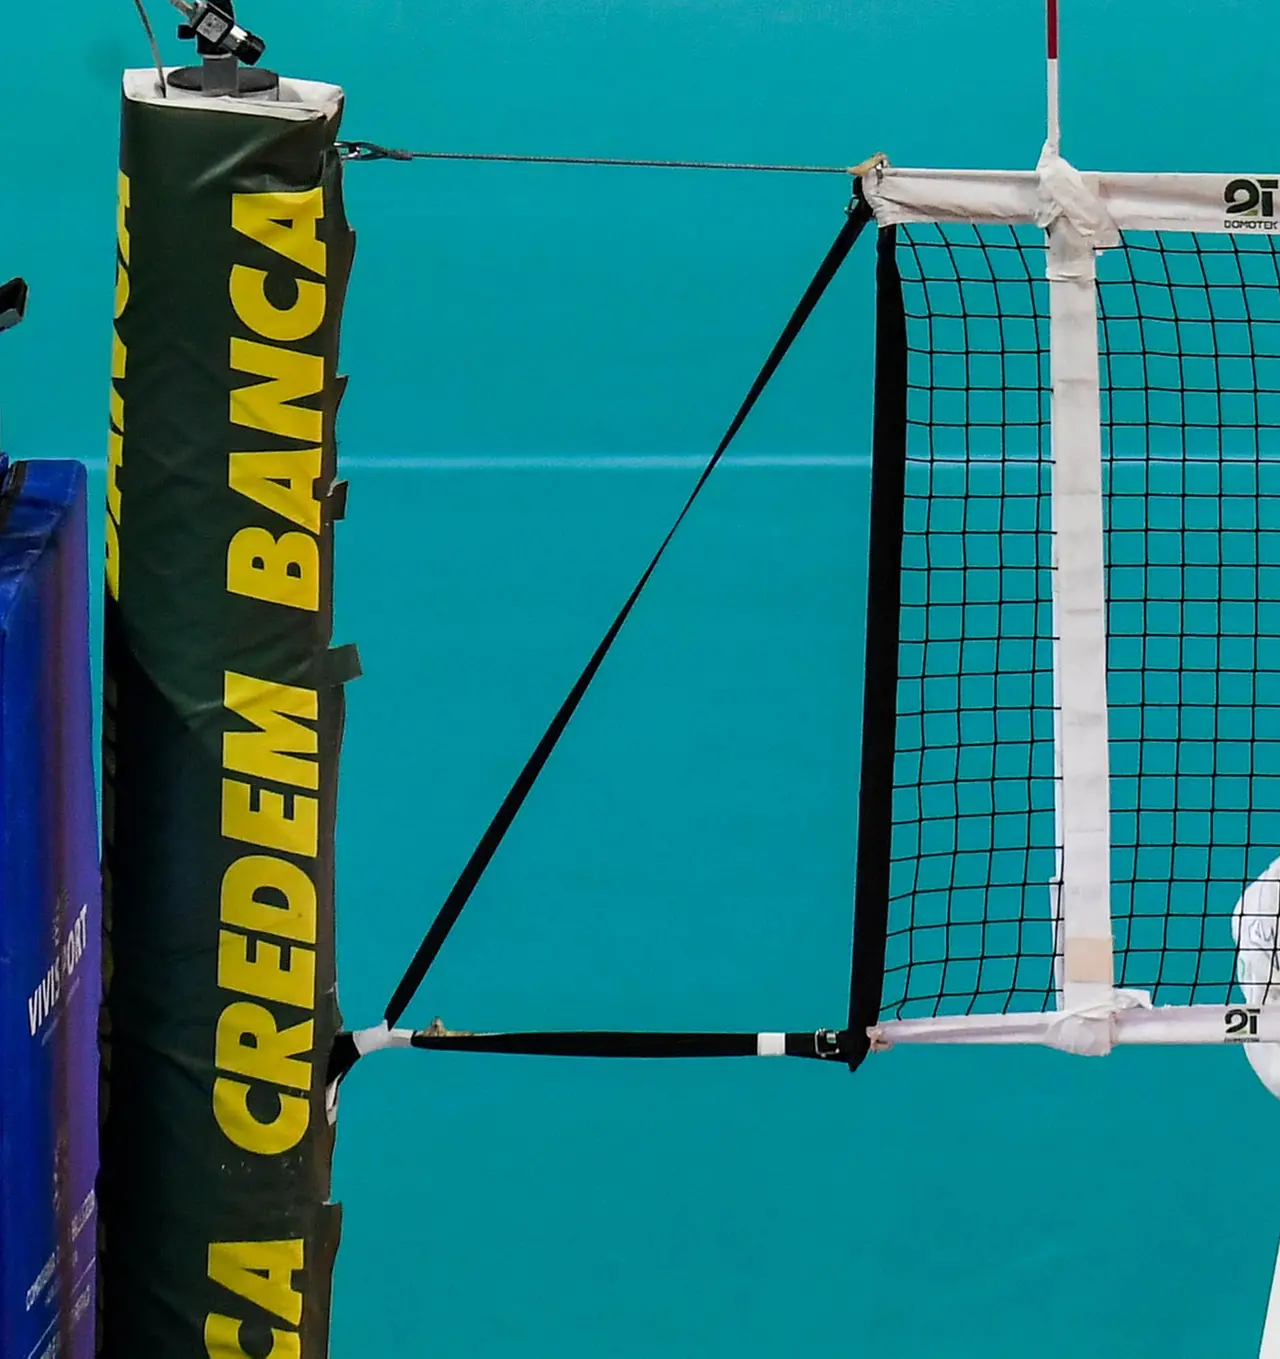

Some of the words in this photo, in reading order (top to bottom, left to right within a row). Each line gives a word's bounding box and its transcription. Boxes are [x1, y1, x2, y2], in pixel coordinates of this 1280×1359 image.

[226, 186, 327, 612] BANCA
[1223, 221, 1279, 231] DOMOTEK
[212, 670, 320, 1156] CREDEM
